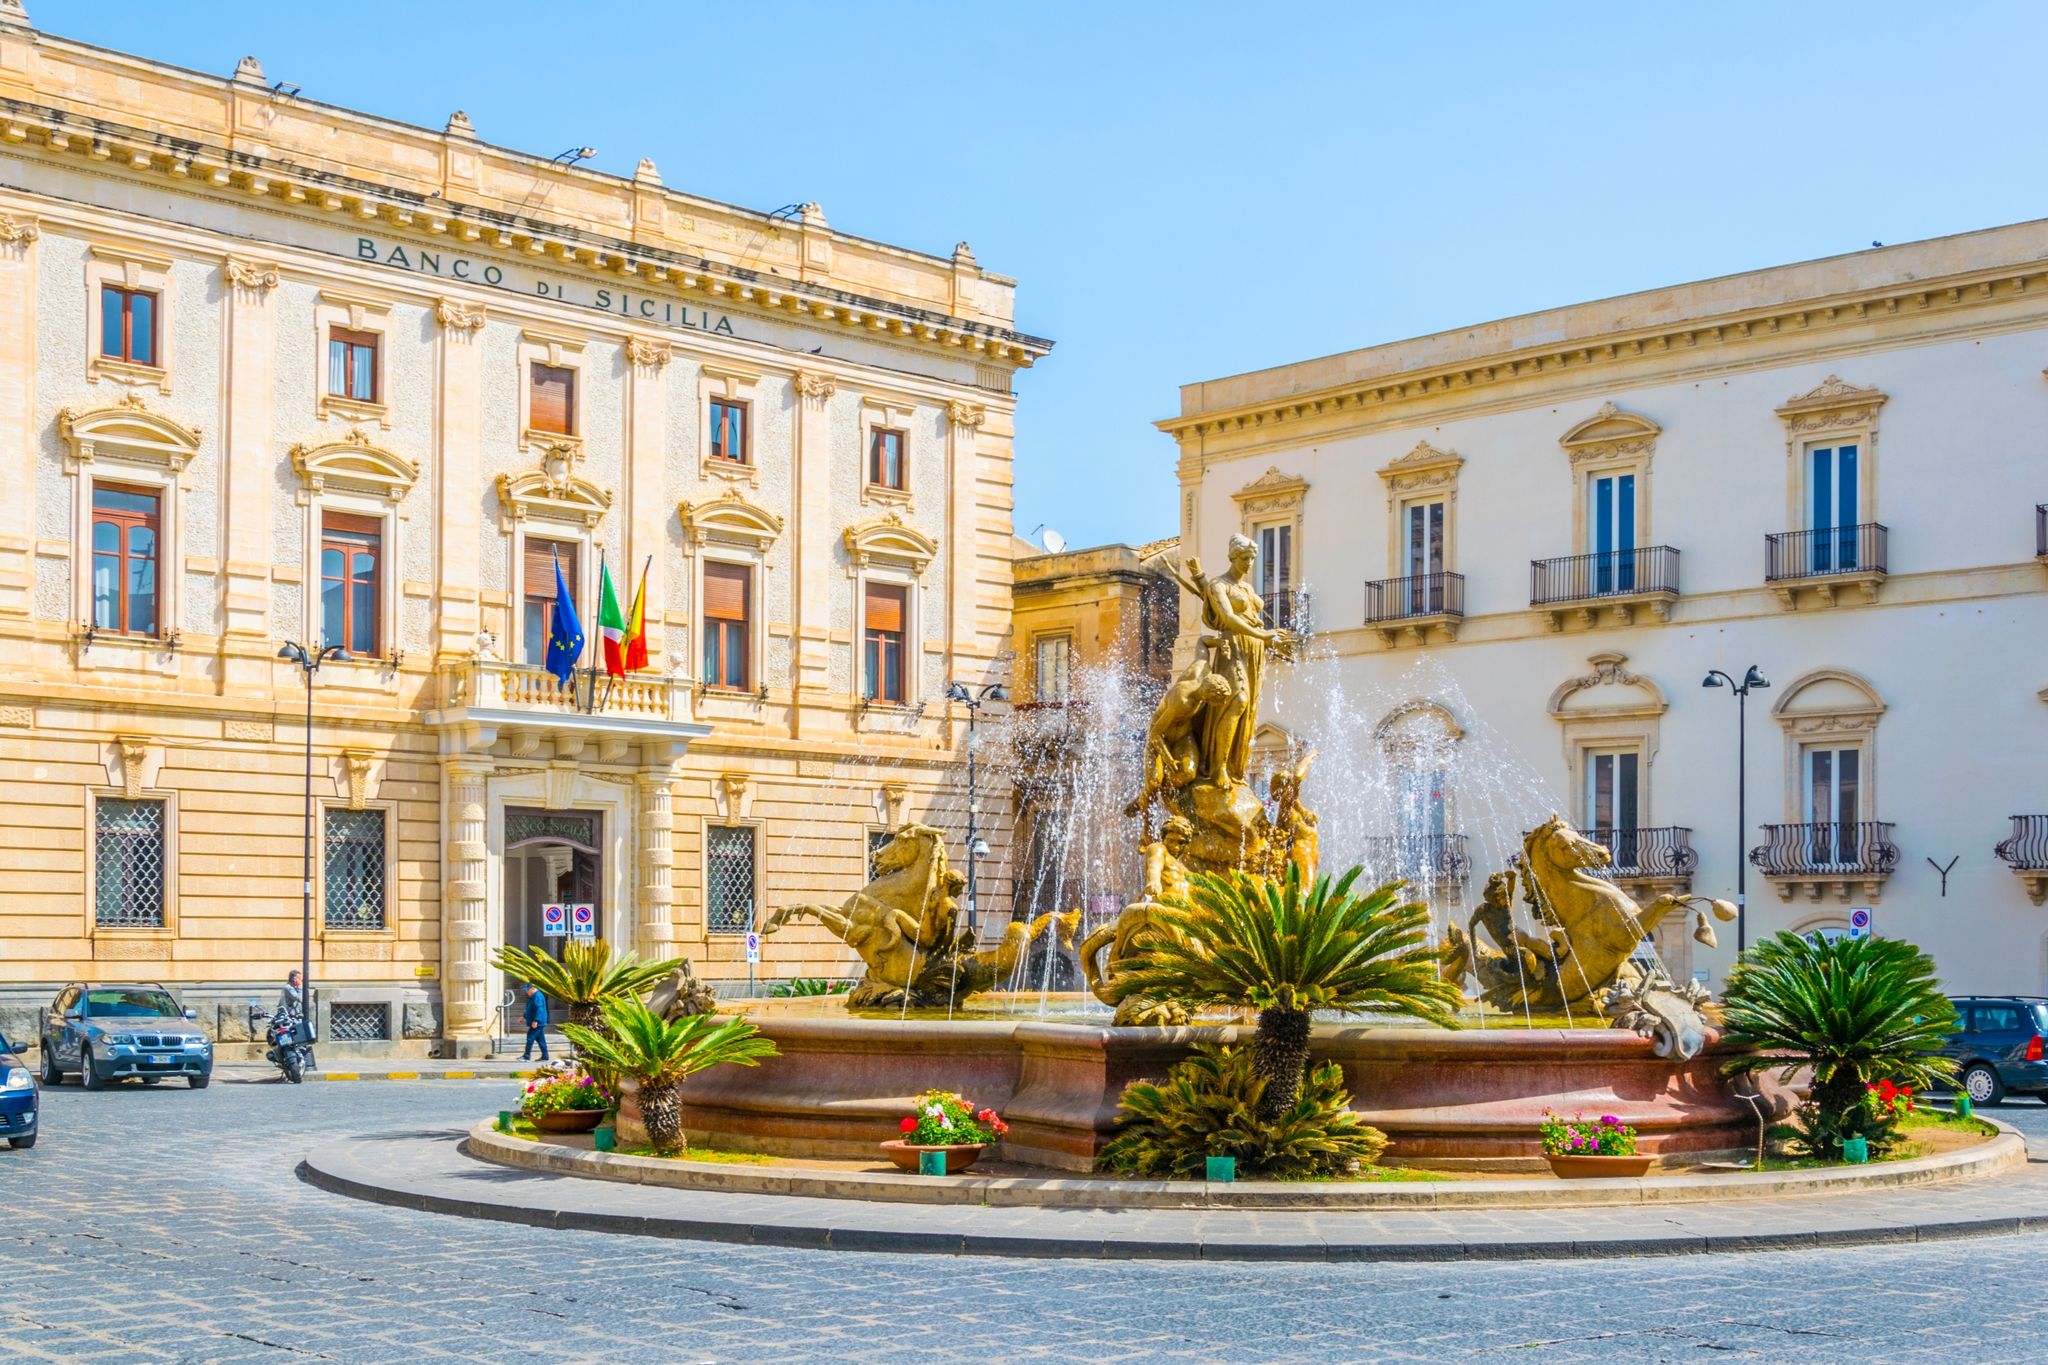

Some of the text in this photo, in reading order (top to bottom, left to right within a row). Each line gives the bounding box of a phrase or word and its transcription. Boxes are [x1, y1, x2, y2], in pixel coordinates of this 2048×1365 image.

[357, 238, 734, 335] BANCO DI SICILIA
